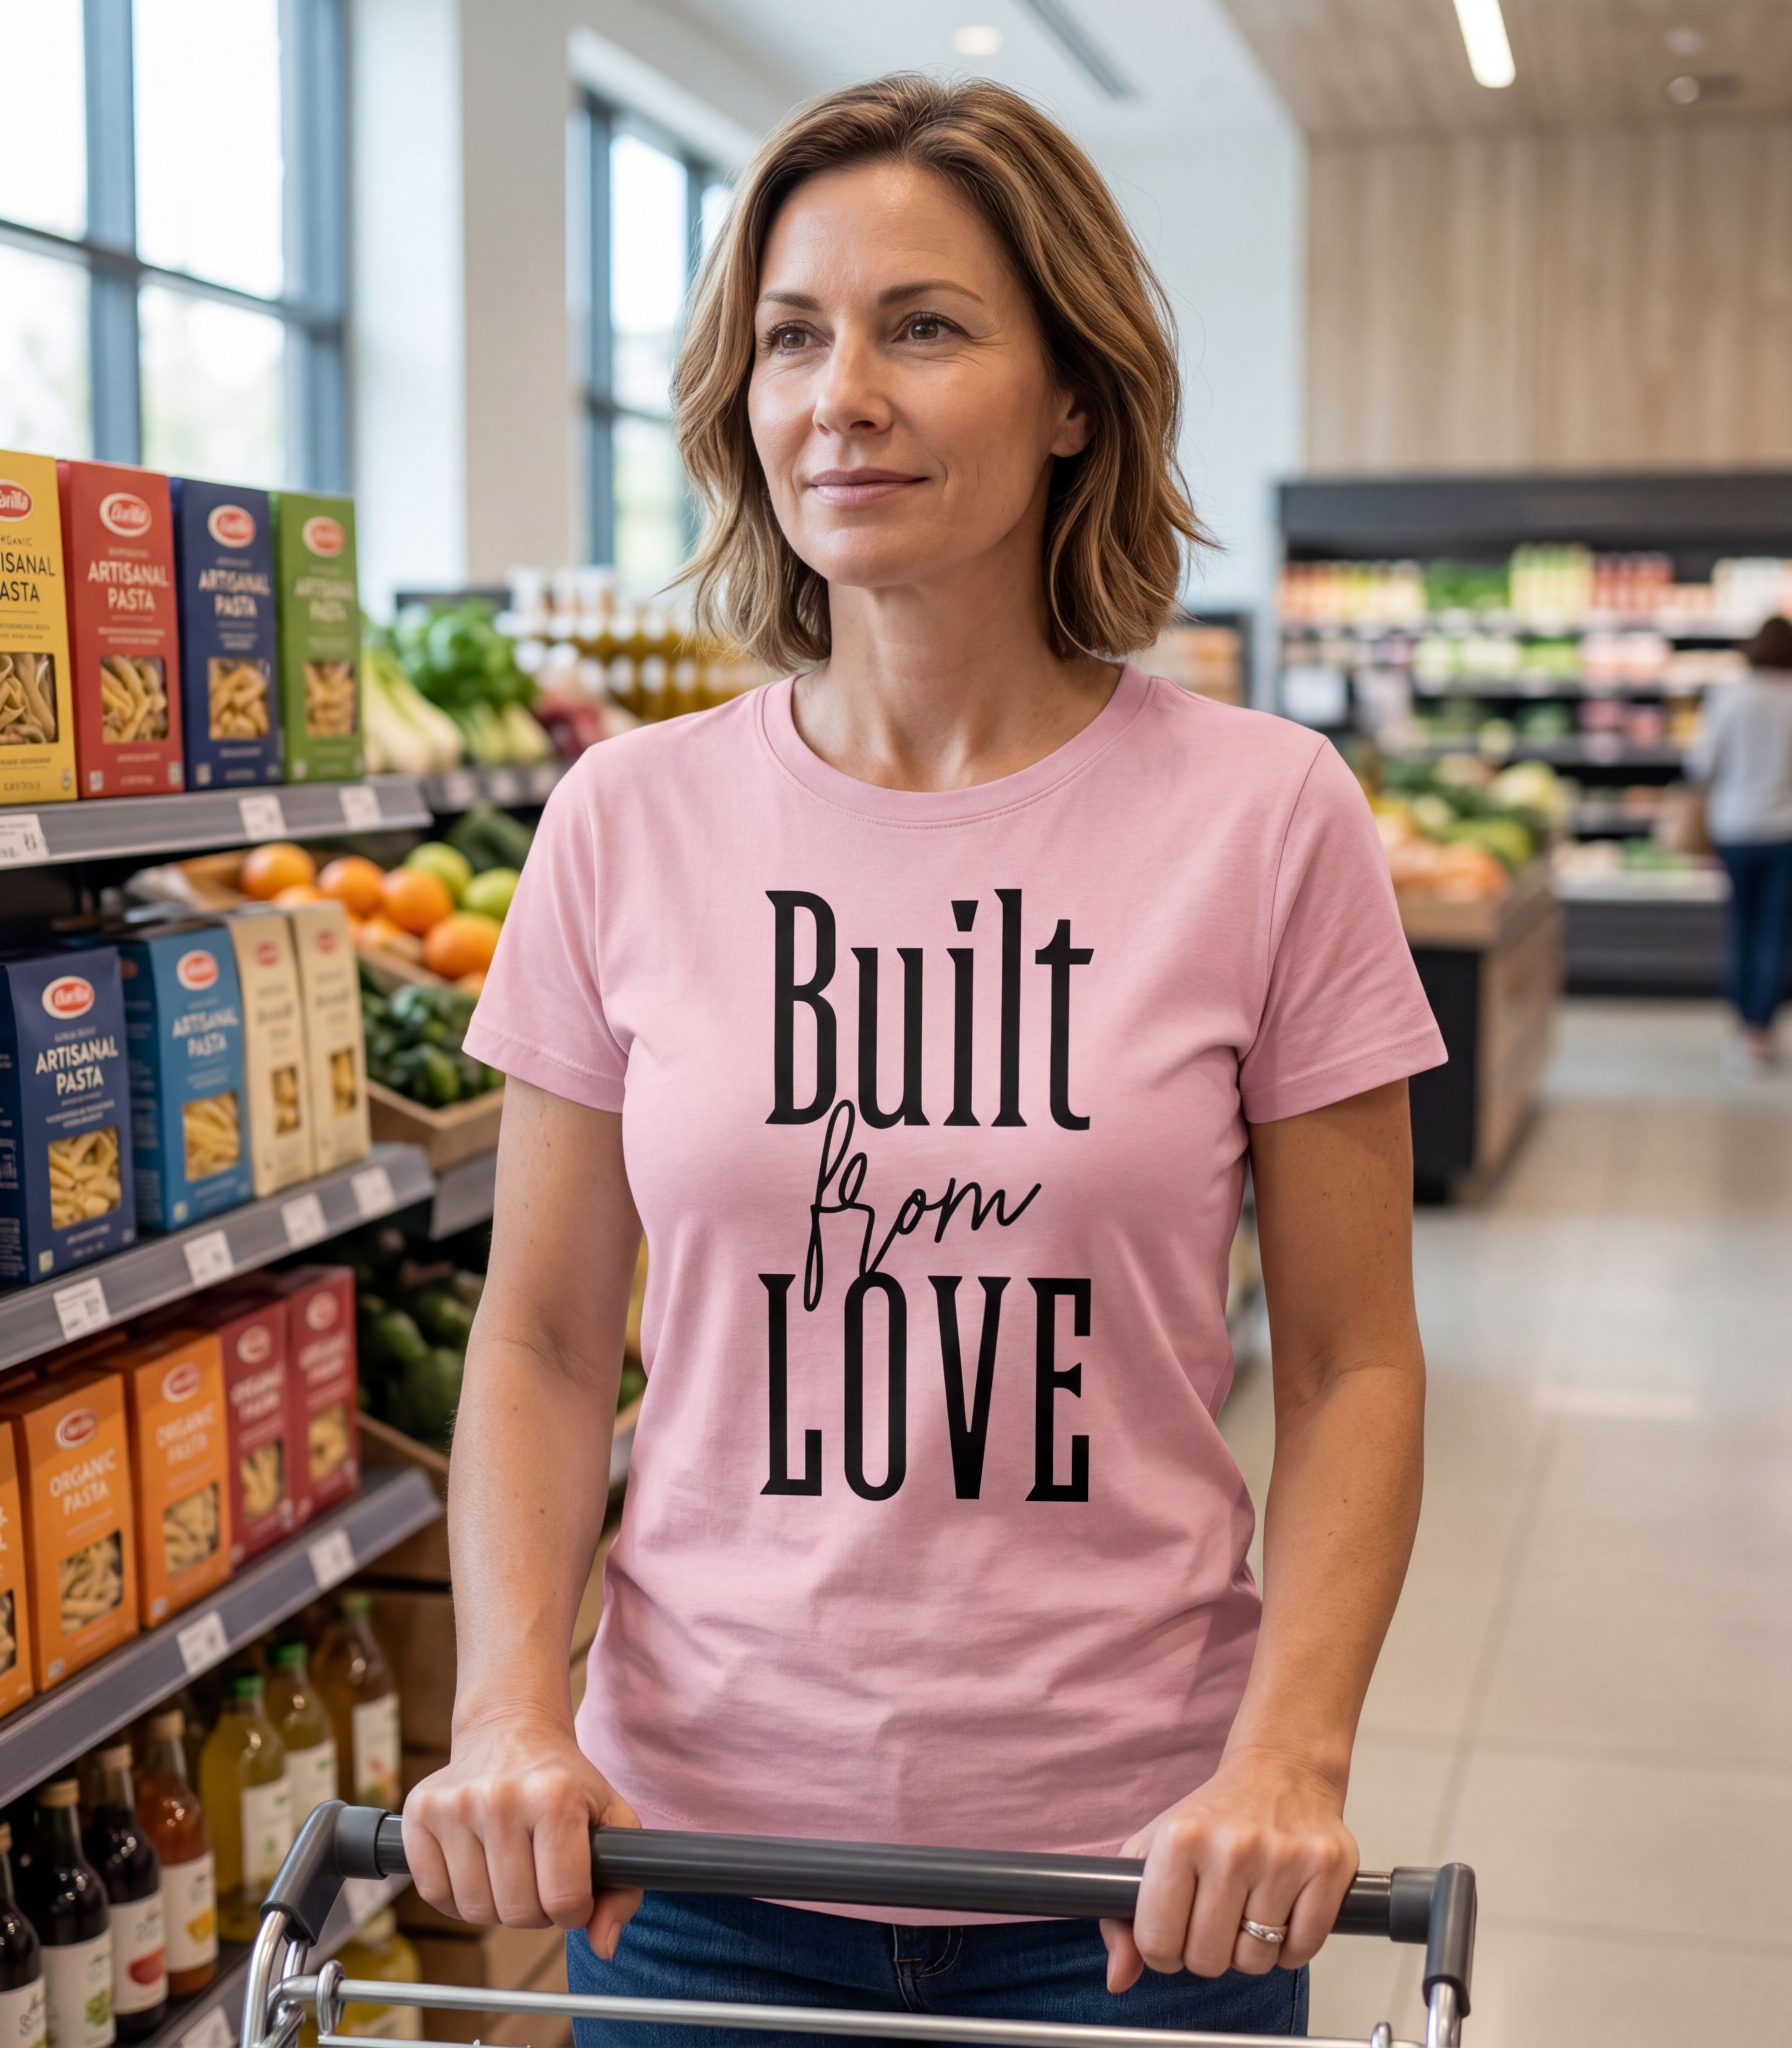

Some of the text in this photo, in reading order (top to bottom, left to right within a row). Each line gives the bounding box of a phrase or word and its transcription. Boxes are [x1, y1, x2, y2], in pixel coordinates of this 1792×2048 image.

[0, 489, 29, 511] arilla
[87, 560, 170, 587] ARTISANAL
[198, 568, 271, 596] ARTISANAL
[107, 587, 156, 612] PASTA
[215, 594, 258, 618] PASTA
[765, 889, 1094, 1130] Built
[35, 1034, 119, 1075] ARTISANAL
[56, 1065, 104, 1096] PASTA
[804, 1099, 1042, 1312] from
[758, 1272, 1092, 1502] LOVE
[49, 1448, 116, 1498] ORGANIC
[63, 1479, 109, 1516] PASTA
